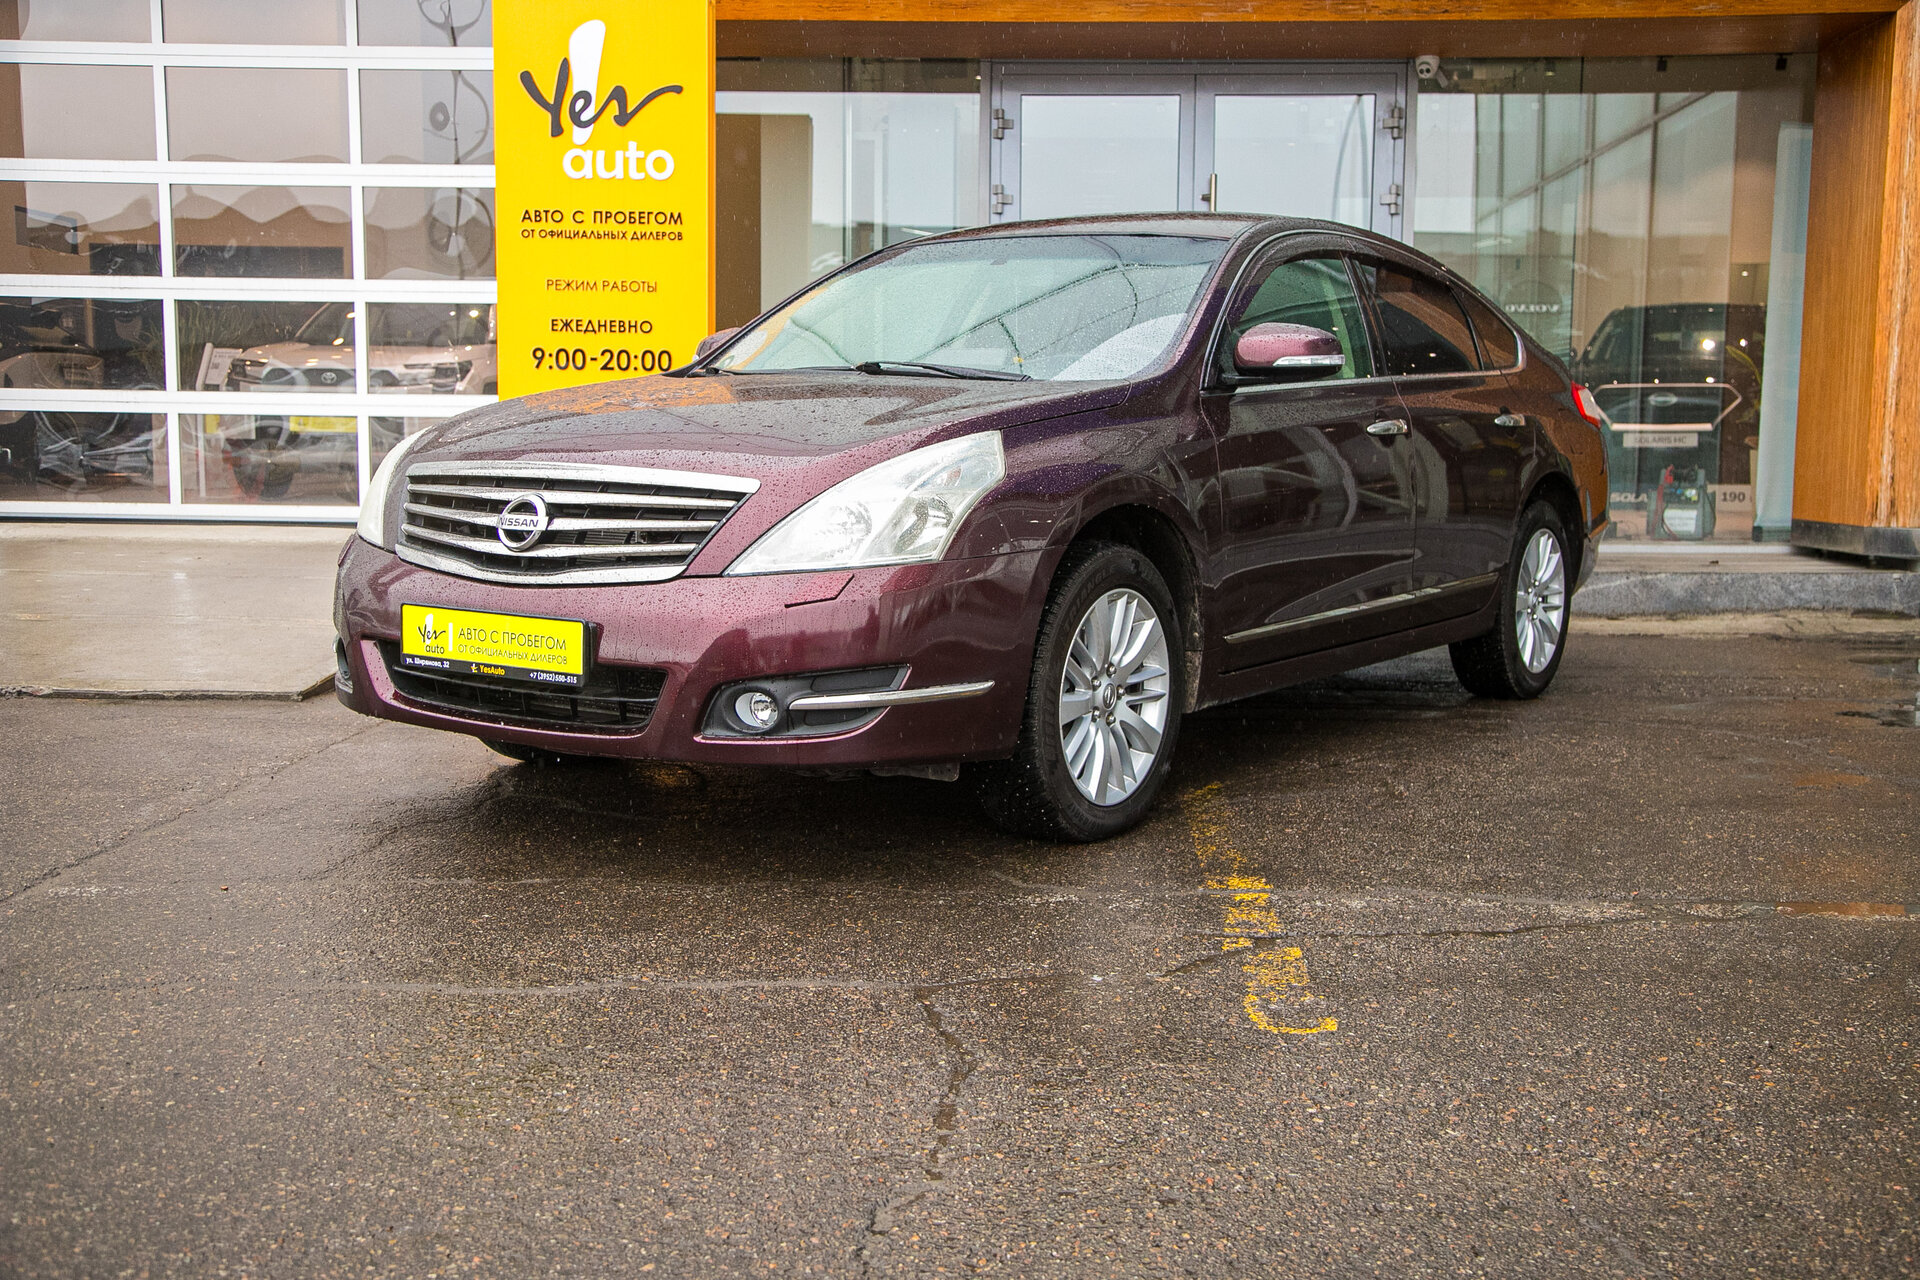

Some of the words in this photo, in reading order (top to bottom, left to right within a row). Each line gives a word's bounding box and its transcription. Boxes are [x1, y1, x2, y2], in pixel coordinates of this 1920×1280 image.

[519, 57, 683, 138] Yes
[562, 140, 675, 181] auto
[521, 209, 564, 224] АВТО
[572, 210, 585, 224] С
[593, 211, 683, 226] ПРОБЕГОМ
[521, 229, 535, 239] ОТ
[538, 229, 628, 241] ОФИЦИАЛЬНЫХ
[630, 231, 683, 242] ДИЛЕРОВ
[546, 279, 598, 292] РЕЖИМ
[602, 280, 658, 293] РАБОТЫ
[551, 318, 653, 334] ЕЖЕДНЕВНО
[532, 347, 672, 372] 9:00-20:00
[1610, 492, 1648, 503] SOLA
[1721, 490, 1746, 503] 190
[499, 517, 539, 528] NISSAN
[458, 627, 487, 642] АВТО
[490, 630, 499, 643] С
[502, 631, 567, 650] ПРОБЕГОМ
[425, 644, 445, 654] auto
[457, 644, 468, 653] ОТ
[469, 645, 528, 661] ОФИЦИАЛЬНЫХ
[529, 652, 568, 665] ДИЛЕРОВ
[479, 664, 505, 676] YesAuto
